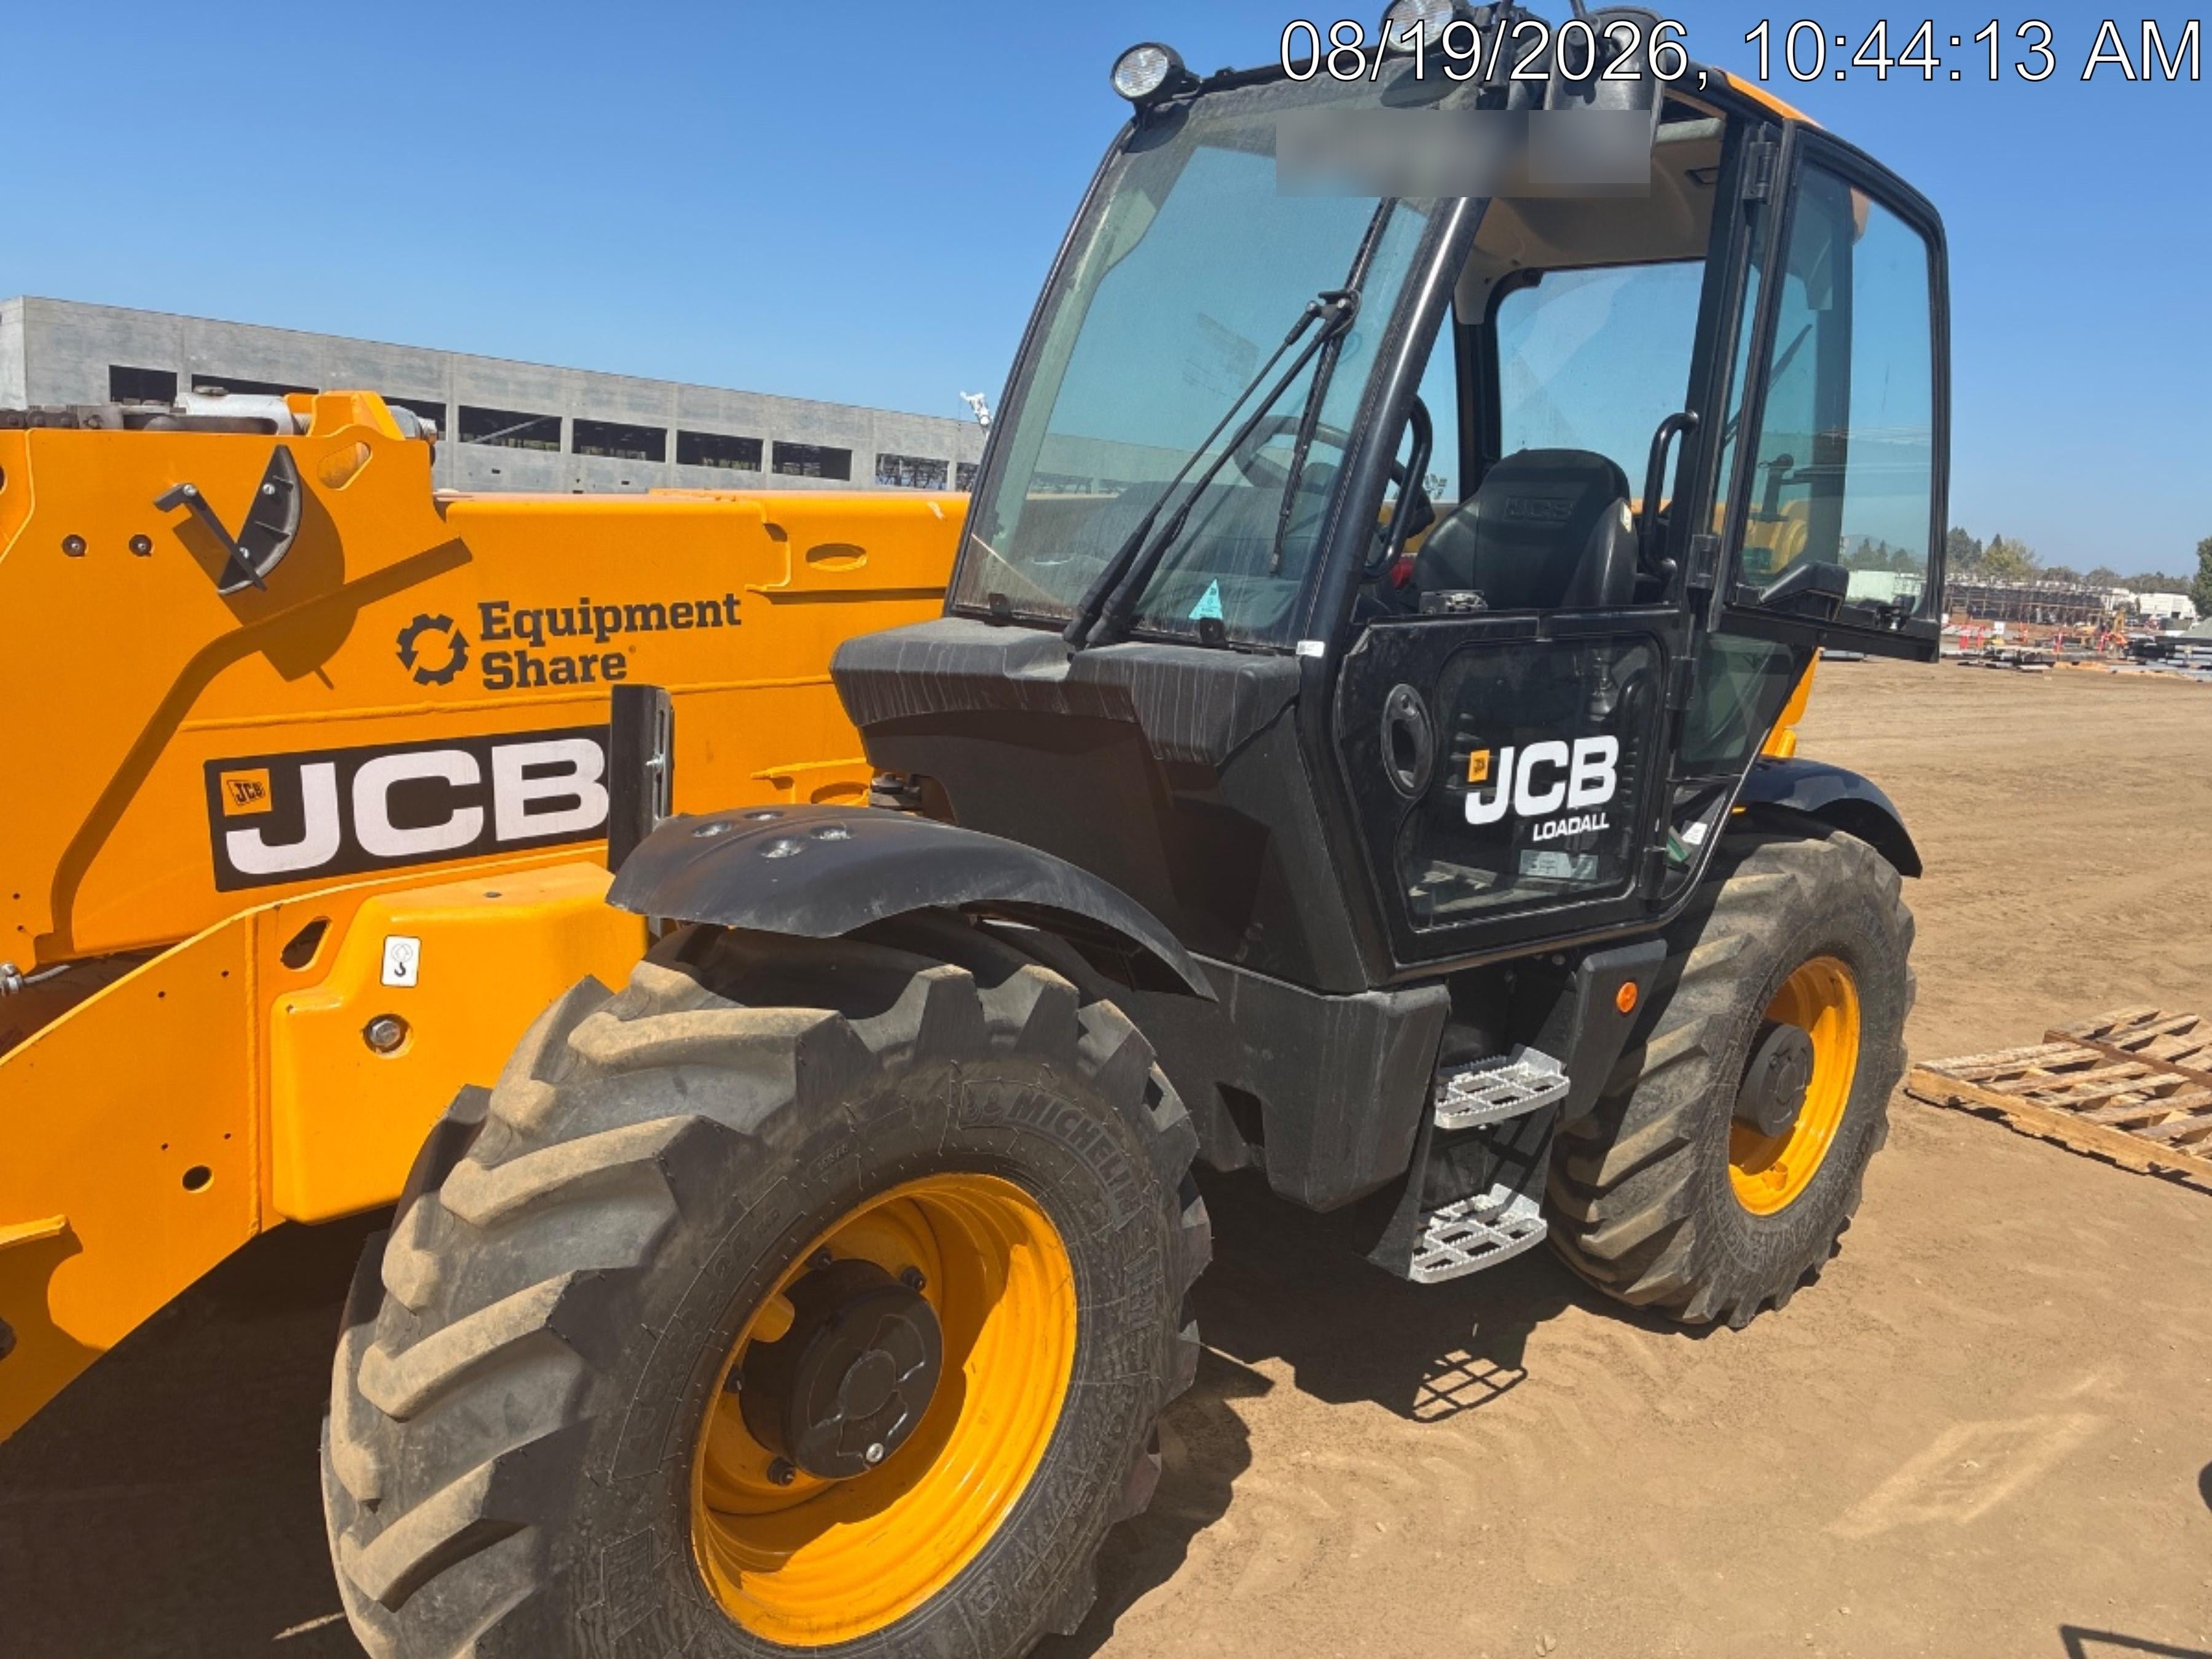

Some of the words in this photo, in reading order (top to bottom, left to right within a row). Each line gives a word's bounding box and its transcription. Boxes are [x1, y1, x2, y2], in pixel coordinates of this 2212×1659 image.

[477, 593, 742, 648] Equipment
[481, 651, 627, 691] Share
[226, 739, 610, 875] JCB
[1465, 735, 1620, 825] JCB
[1532, 812, 1610, 842] LOADALL
